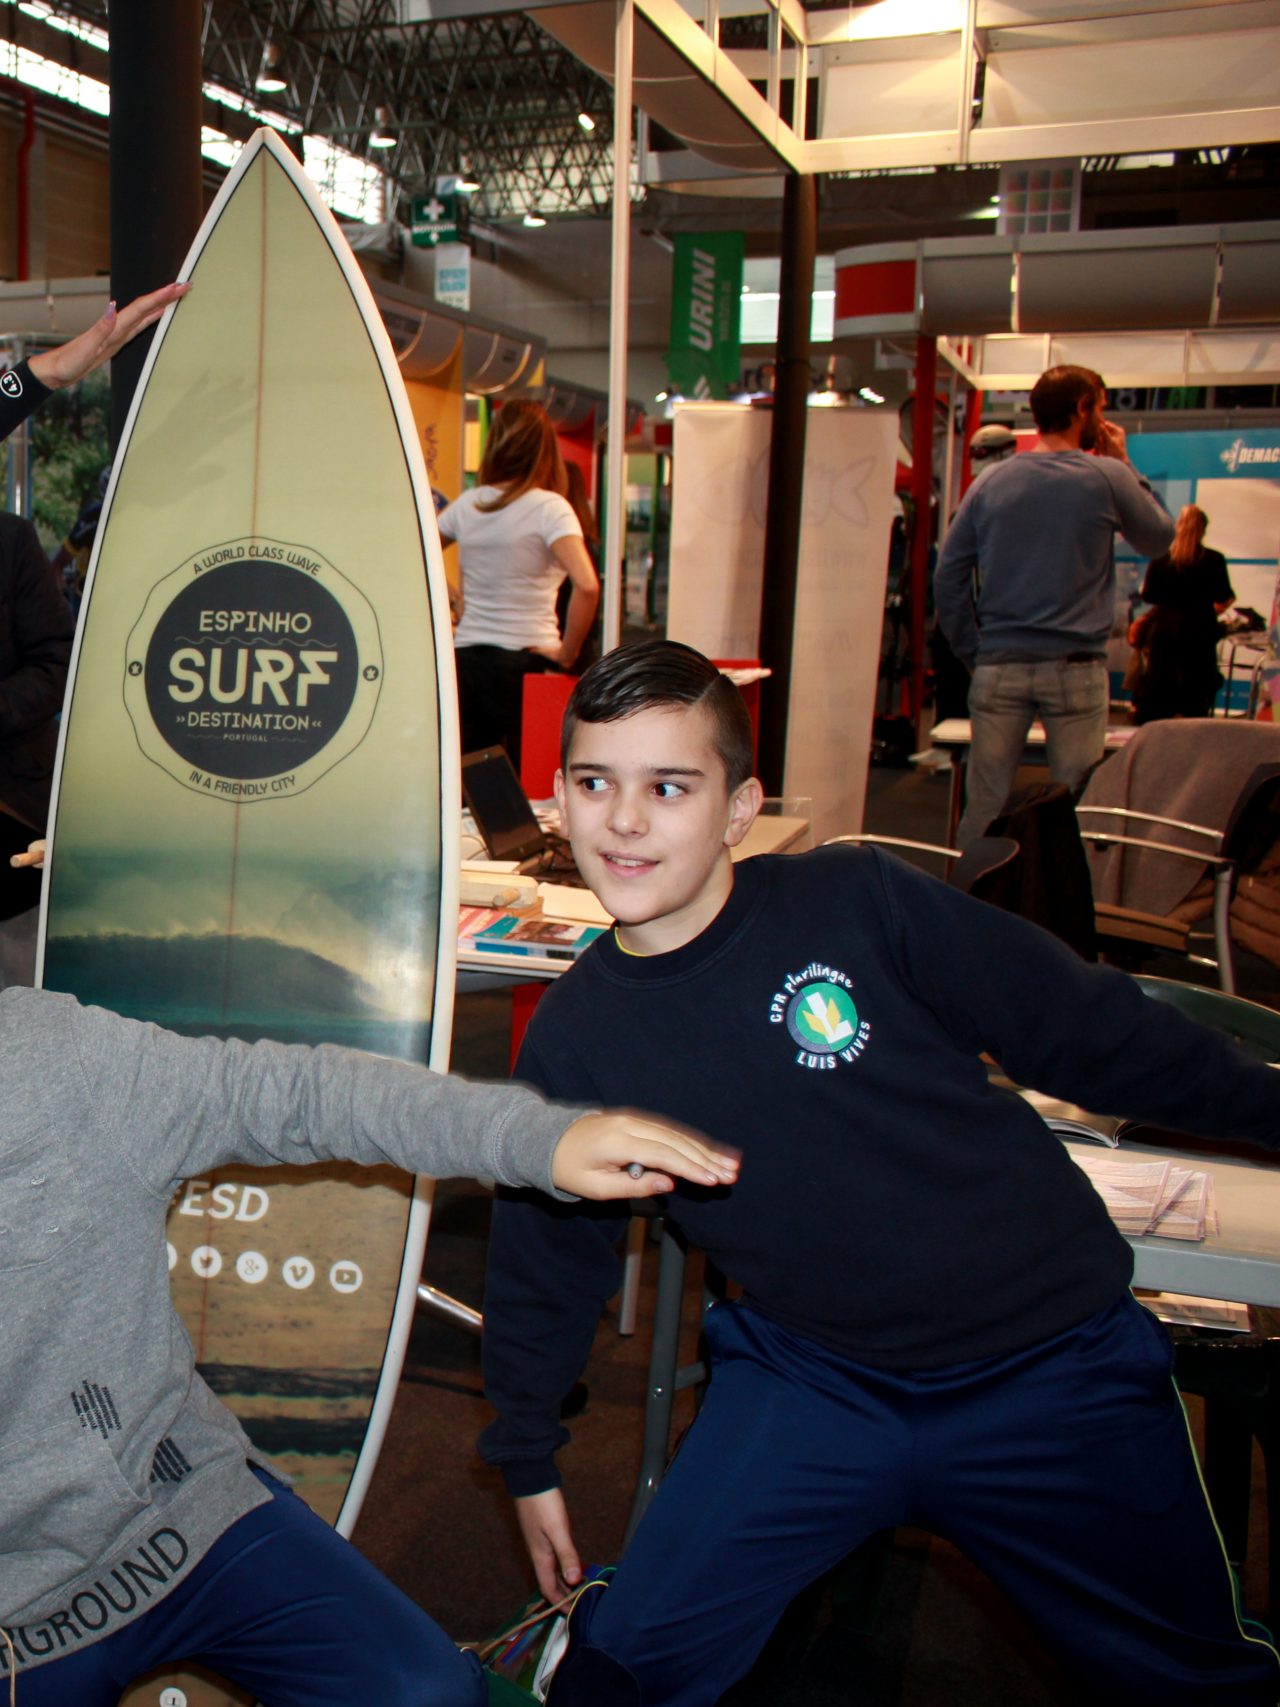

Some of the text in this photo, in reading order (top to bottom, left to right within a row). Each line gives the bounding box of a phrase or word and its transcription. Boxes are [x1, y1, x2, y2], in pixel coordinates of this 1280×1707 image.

[193, 545, 322, 576] A WORLD CLASS WAVE
[199, 610, 312, 633] ESPINHO
[168, 647, 338, 707] SURF
[187, 711, 309, 730] DESTINATION
[223, 733, 268, 743] PORTUGAL
[189, 770, 296, 795] IN A FRIENDLY CITY
[797, 1021, 871, 1069] LUIS VIVES
[172, 1180, 269, 1222] ESD
